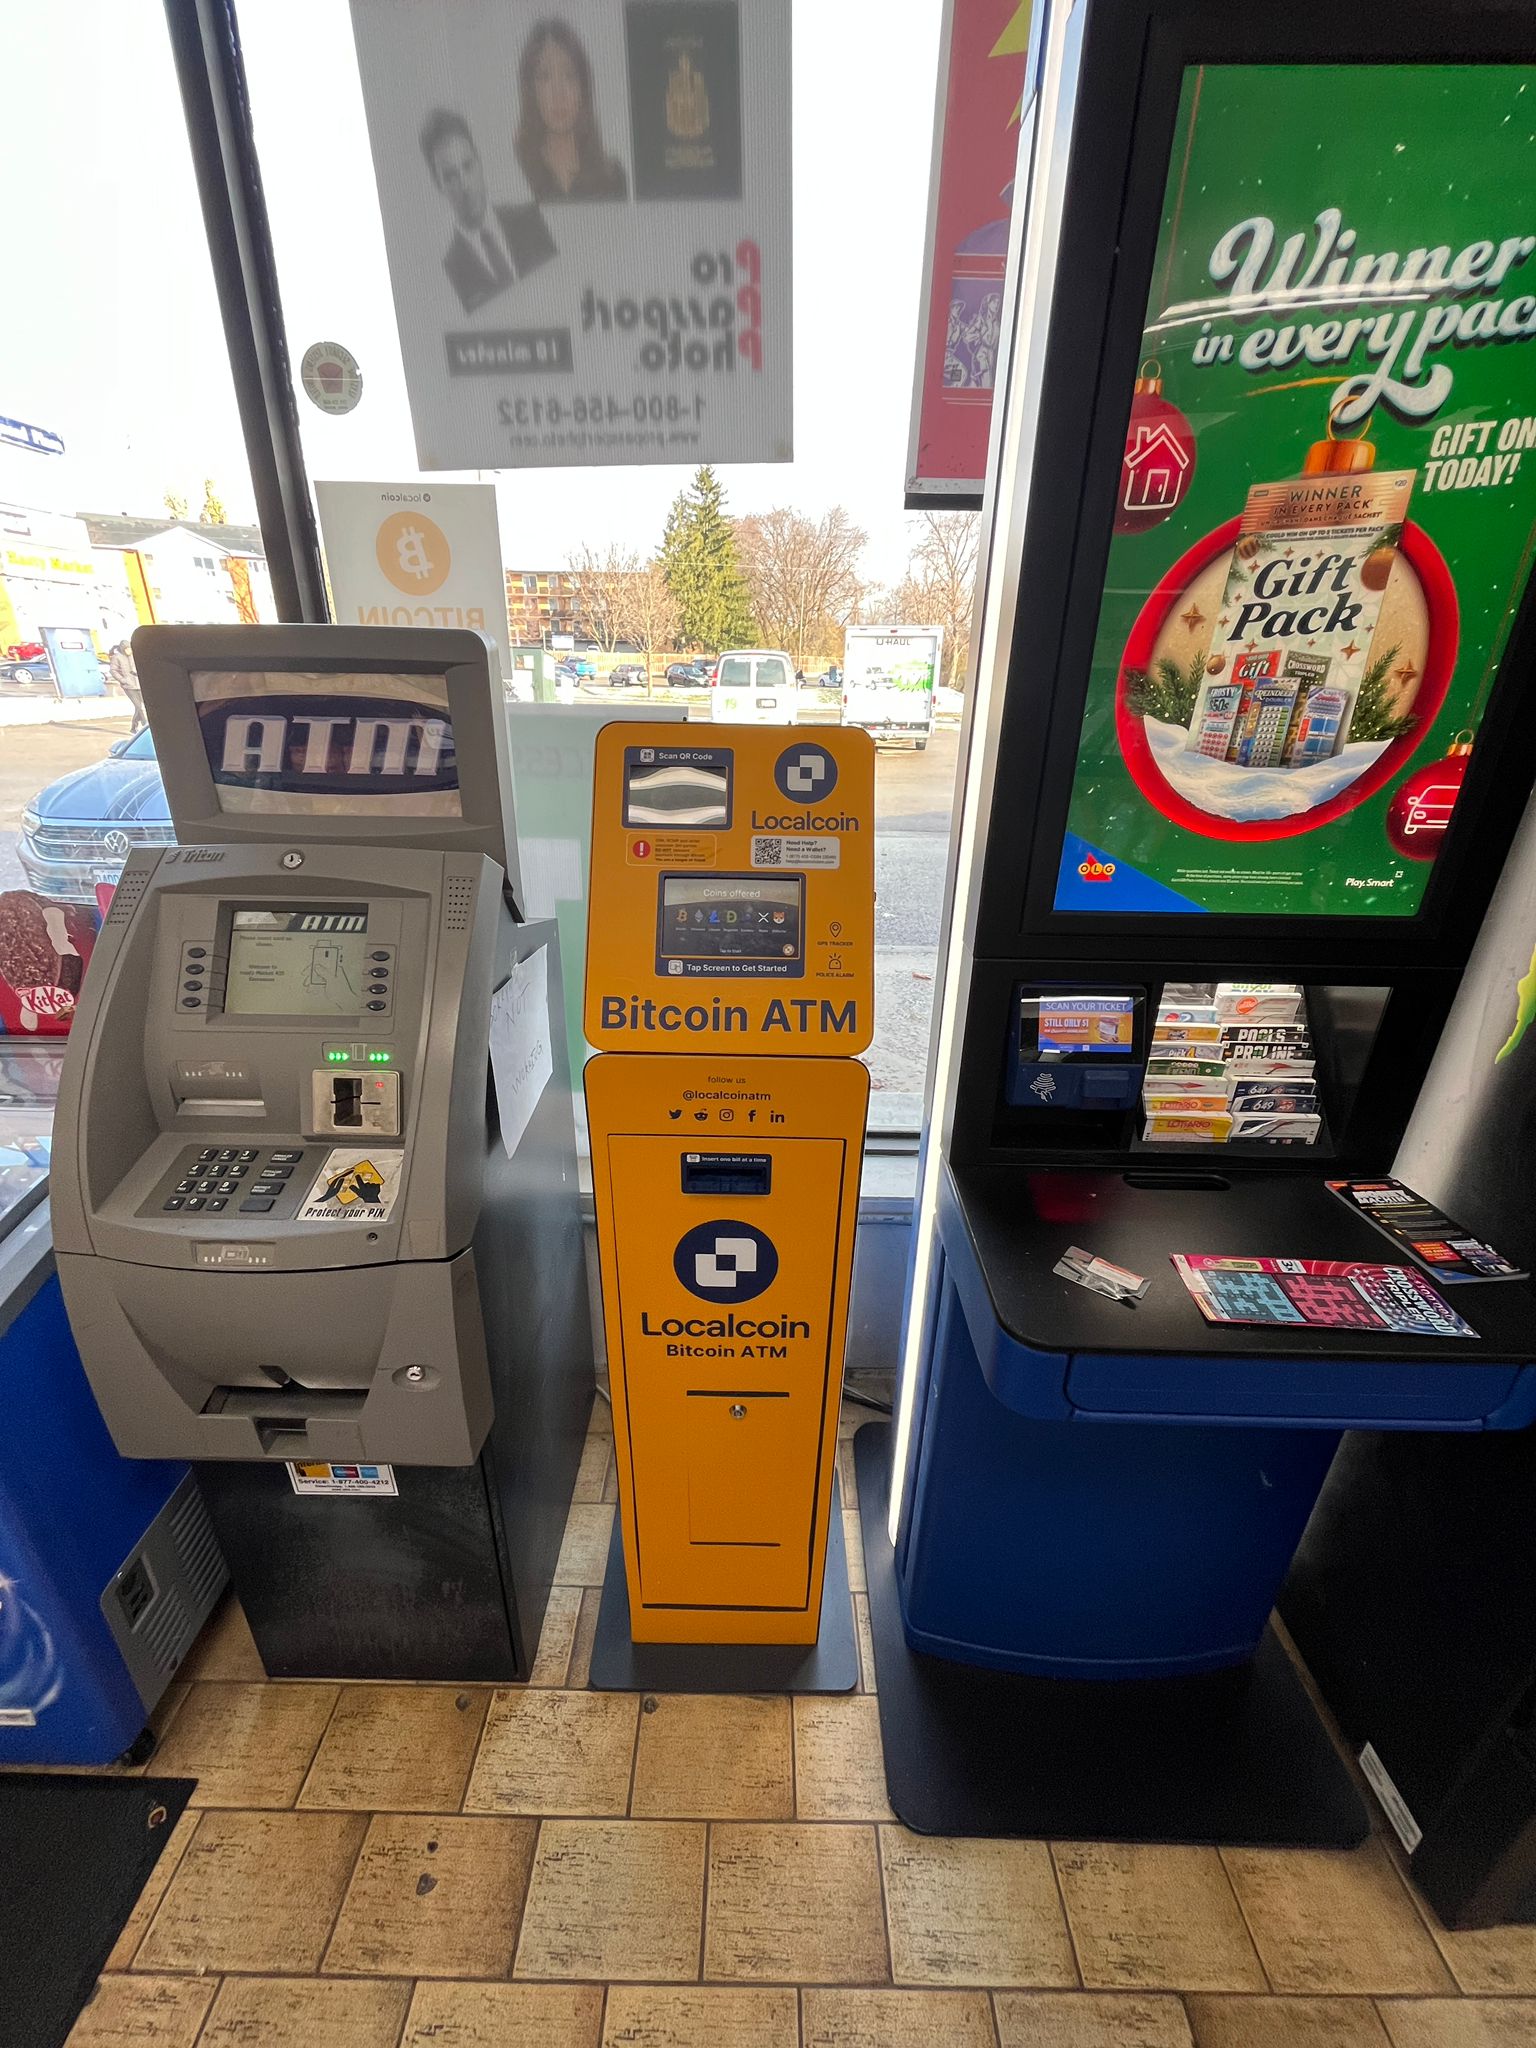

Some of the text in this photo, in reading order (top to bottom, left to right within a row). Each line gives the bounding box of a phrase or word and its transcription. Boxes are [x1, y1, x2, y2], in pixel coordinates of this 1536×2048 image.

[1209, 207, 1536, 309] Winner
[1192, 321, 1234, 364] in
[1239, 310, 1453, 425] every
[1430, 421, 1498, 458] GIFT
[1423, 452, 1522, 492] TODAY!
[1290, 485, 1363, 502] WINNER
[1273, 507, 1287, 517] IN
[1292, 502, 1331, 514] EVERY
[1253, 553, 1357, 600] Gift
[1227, 592, 1363, 642] Pack
[1239, 660, 1271, 680] Gift
[1288, 659, 1326, 673] CROSSWORD
[1210, 687, 1235, 697] FROSTY
[1254, 690, 1295, 700] REINDEER
[1209, 698, 1230, 711] $50s
[221, 714, 446, 776] ATM
[658, 752, 713, 761] Scan QR Code
[751, 810, 859, 832] Localcoin
[182, 849, 225, 864] Triton
[1078, 862, 1116, 875] OLG
[703, 888, 761, 898] Coins offered
[300, 915, 366, 932] ATM
[687, 963, 701, 973] Tap
[703, 964, 731, 972] Screen
[742, 964, 756, 973] Get
[757, 964, 788, 973] Started
[27, 986, 75, 1014] KitKat
[1046, 1002, 1127, 1011] SCAN YOUR TICKET
[601, 995, 857, 1033] Bitcoin ATM
[1044, 1018, 1064, 1027] STILL
[1064, 1018, 1081, 1027] ONLY
[707, 1075, 734, 1084] follow
[682, 1089, 772, 1101] @localcoinatm
[1249, 1086, 1268, 1094] 649
[1252, 1100, 1275, 1111] 649
[1167, 1120, 1211, 1128] LOTTARIO
[304, 1207, 342, 1219] Protect
[342, 1208, 366, 1220] your
[1381, 1278, 1427, 1322] TRIPLER
[1383, 1267, 1458, 1334] CROSSWORD
[641, 1312, 811, 1339] Localcoin
[666, 1344, 788, 1359] Bitcoin ATM
